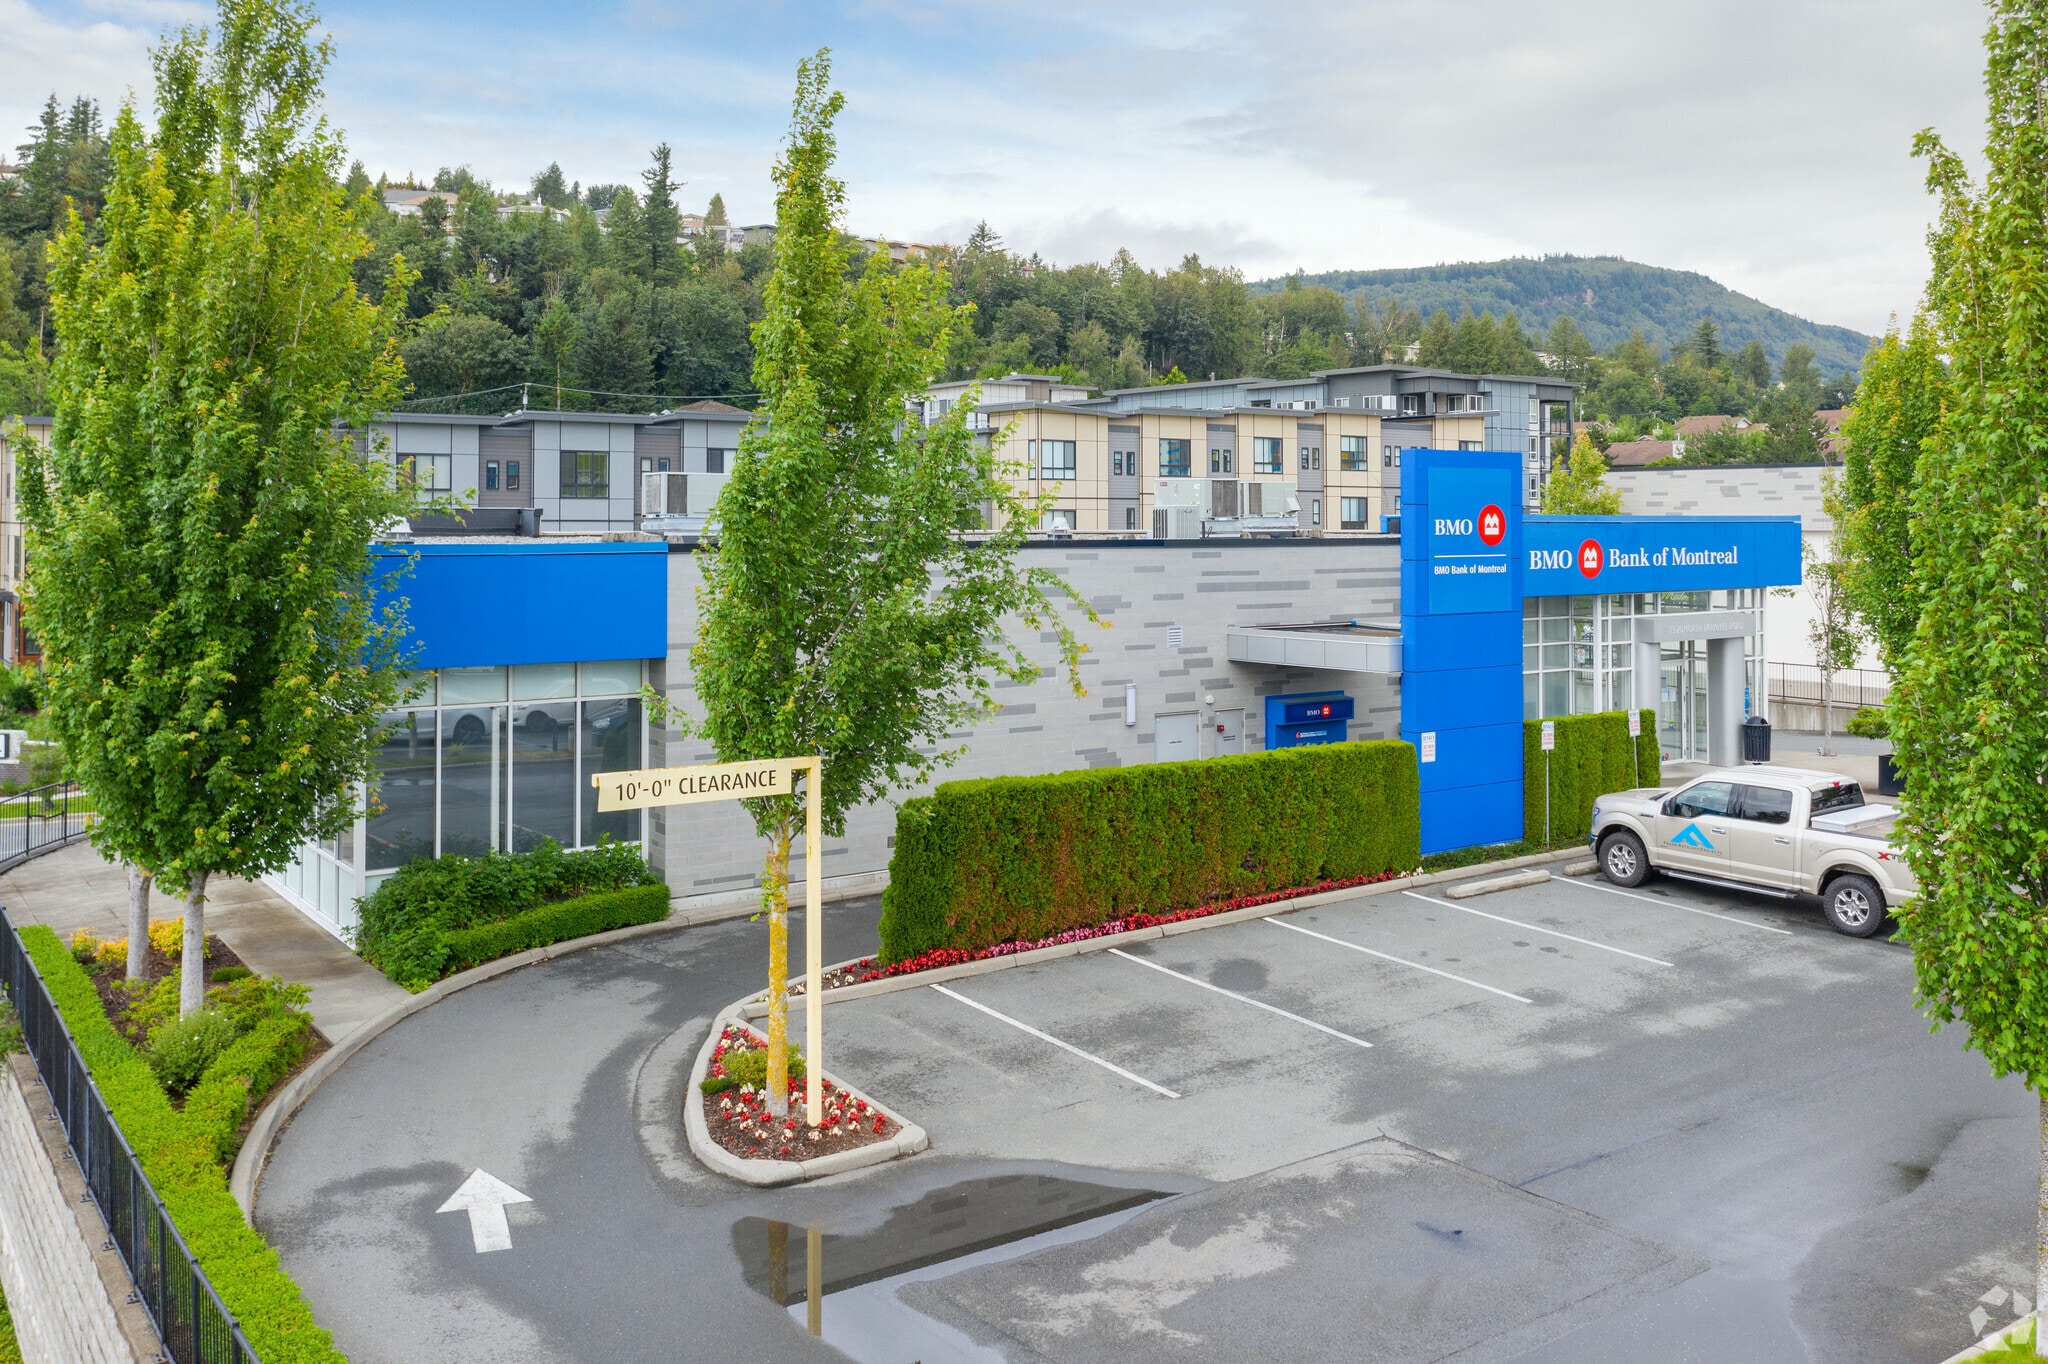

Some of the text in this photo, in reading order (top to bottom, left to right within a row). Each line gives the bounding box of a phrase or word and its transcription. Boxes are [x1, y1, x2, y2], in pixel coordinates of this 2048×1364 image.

[1434, 518, 1473, 536] BMO
[1528, 546, 1738, 570] BMO Bank of Montreal
[1434, 563, 1507, 575] BMO Bank of Montreal
[1684, 624, 1703, 633] NORTH
[1703, 622, 1728, 632] PARALLEL
[1729, 621, 1744, 630] ROAD
[615, 769, 777, 801] 10'-0" CLEARANCE
